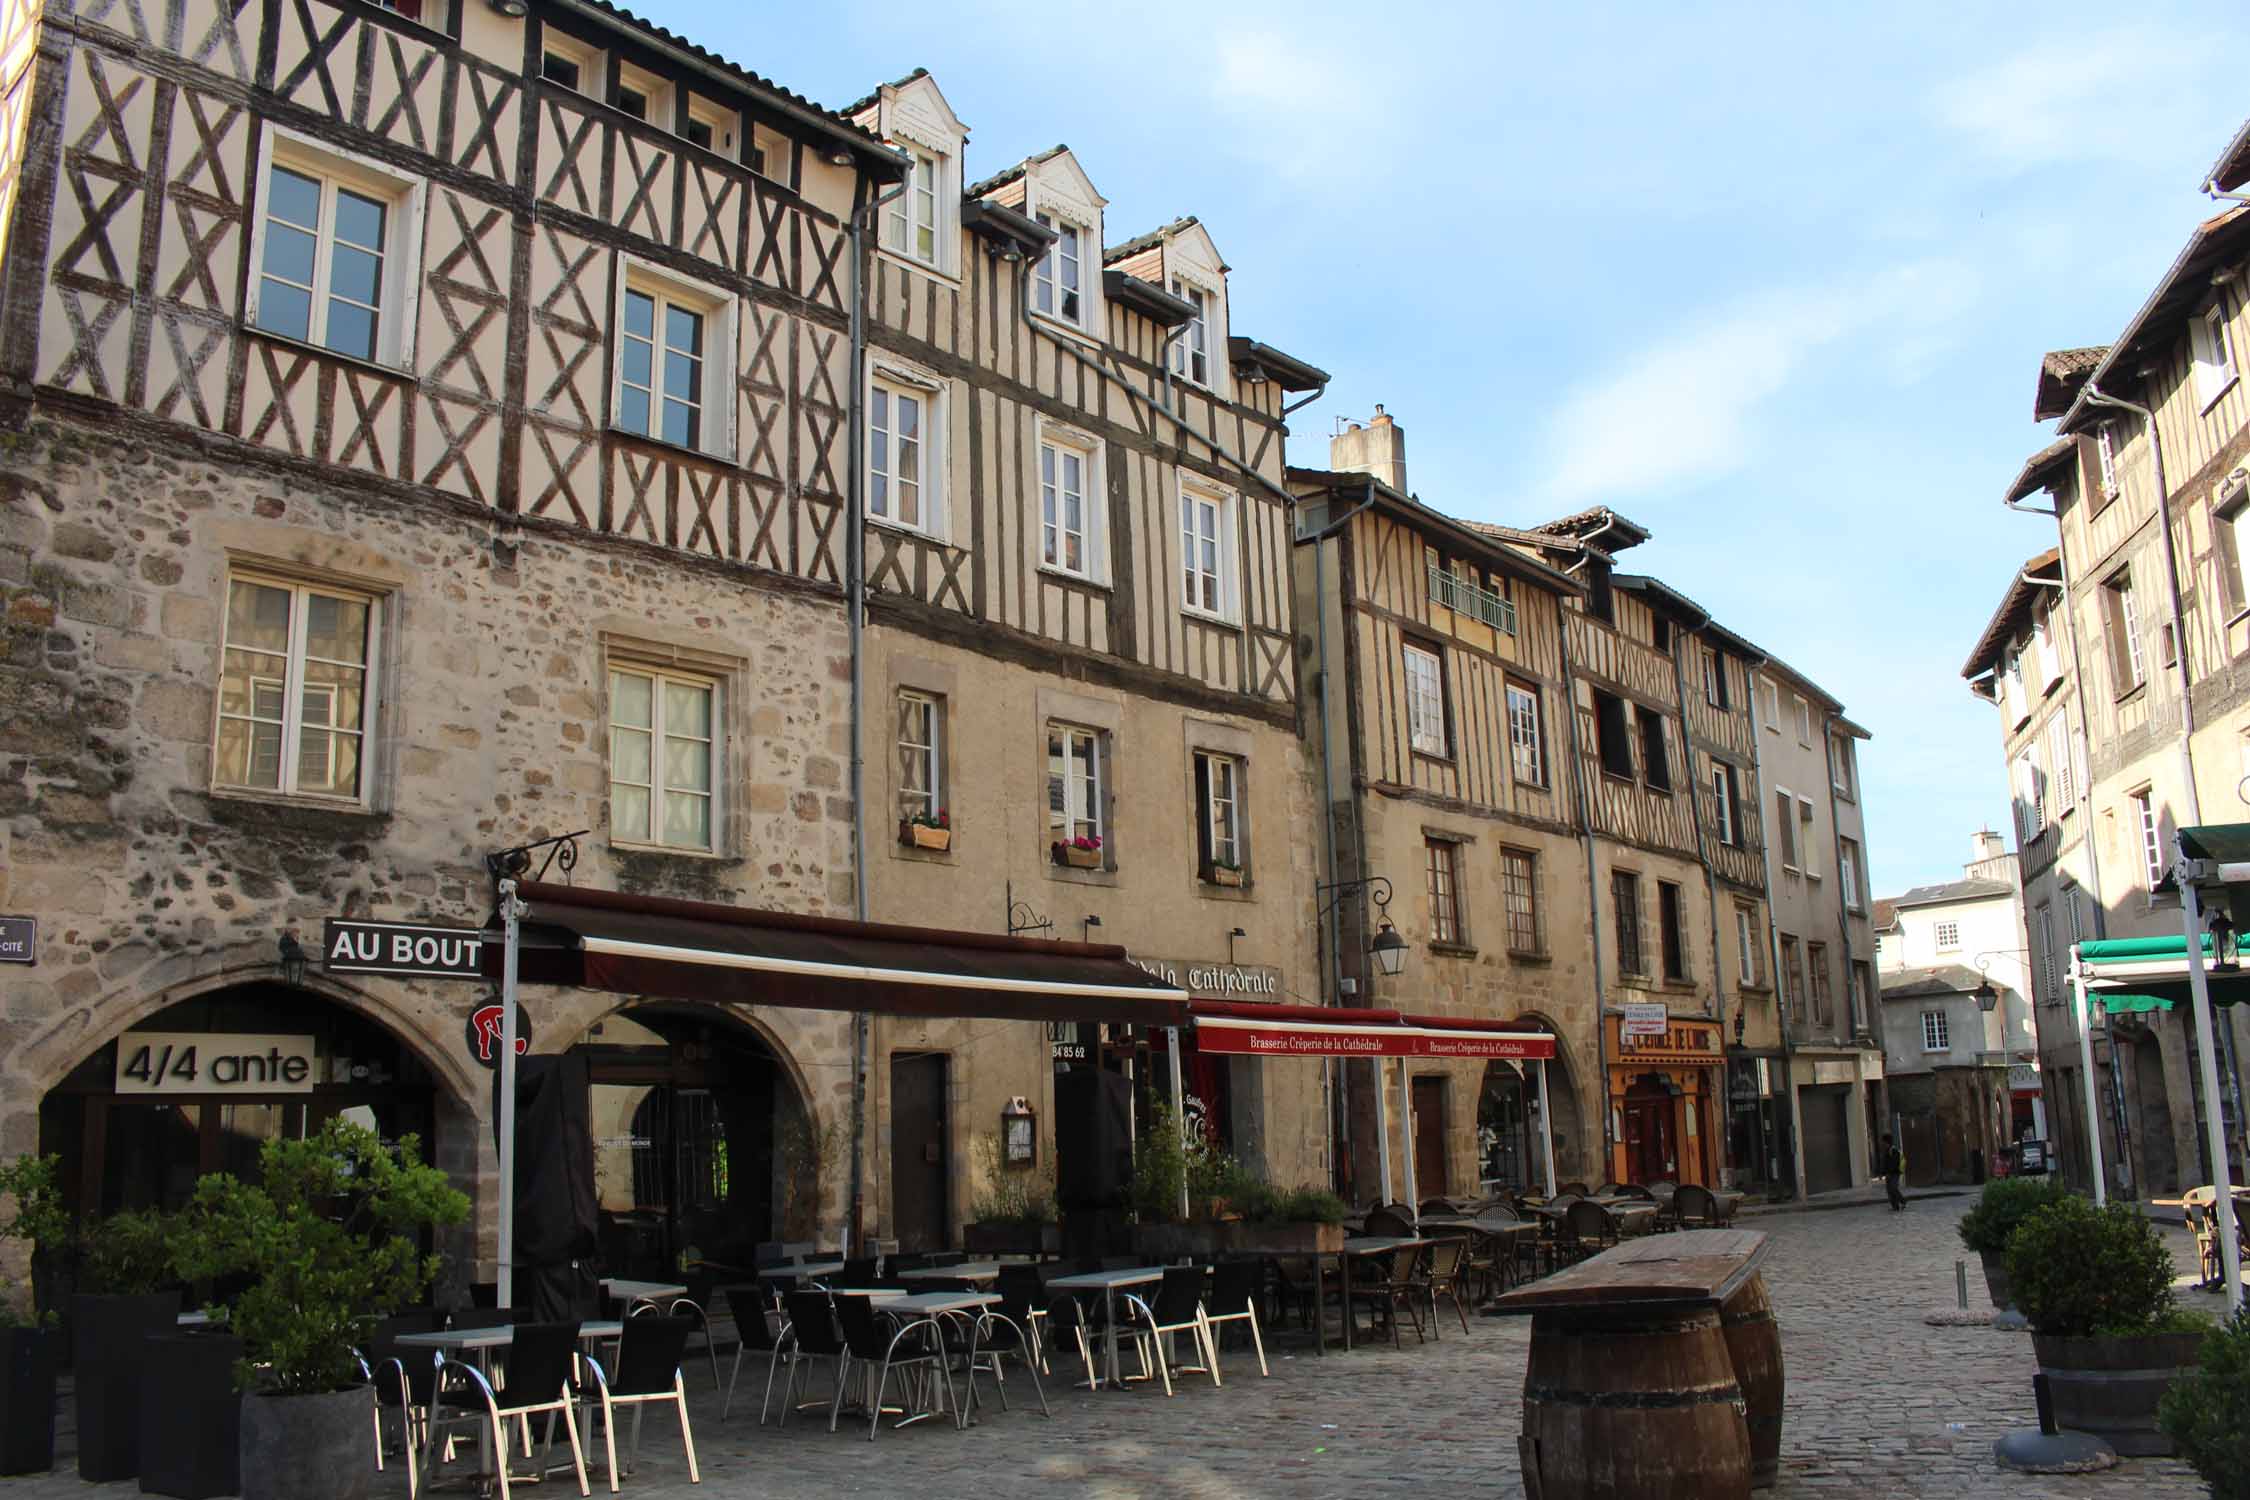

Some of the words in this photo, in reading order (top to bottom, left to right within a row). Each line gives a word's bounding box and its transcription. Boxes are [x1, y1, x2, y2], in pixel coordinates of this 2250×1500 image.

[331, 931, 380, 961] AU
[392, 935, 482, 967] BOUT
[1063, 1046, 1074, 1058] 85
[1250, 1035, 1288, 1049] Brasserie
[1289, 1036, 1322, 1051] Crêperie
[1323, 1037, 1333, 1049] de
[1334, 1038, 1341, 1050] la
[1343, 1038, 1383, 1051] Cathédrale
[123, 1045, 198, 1086] 4/4
[210, 1048, 309, 1084] ante
